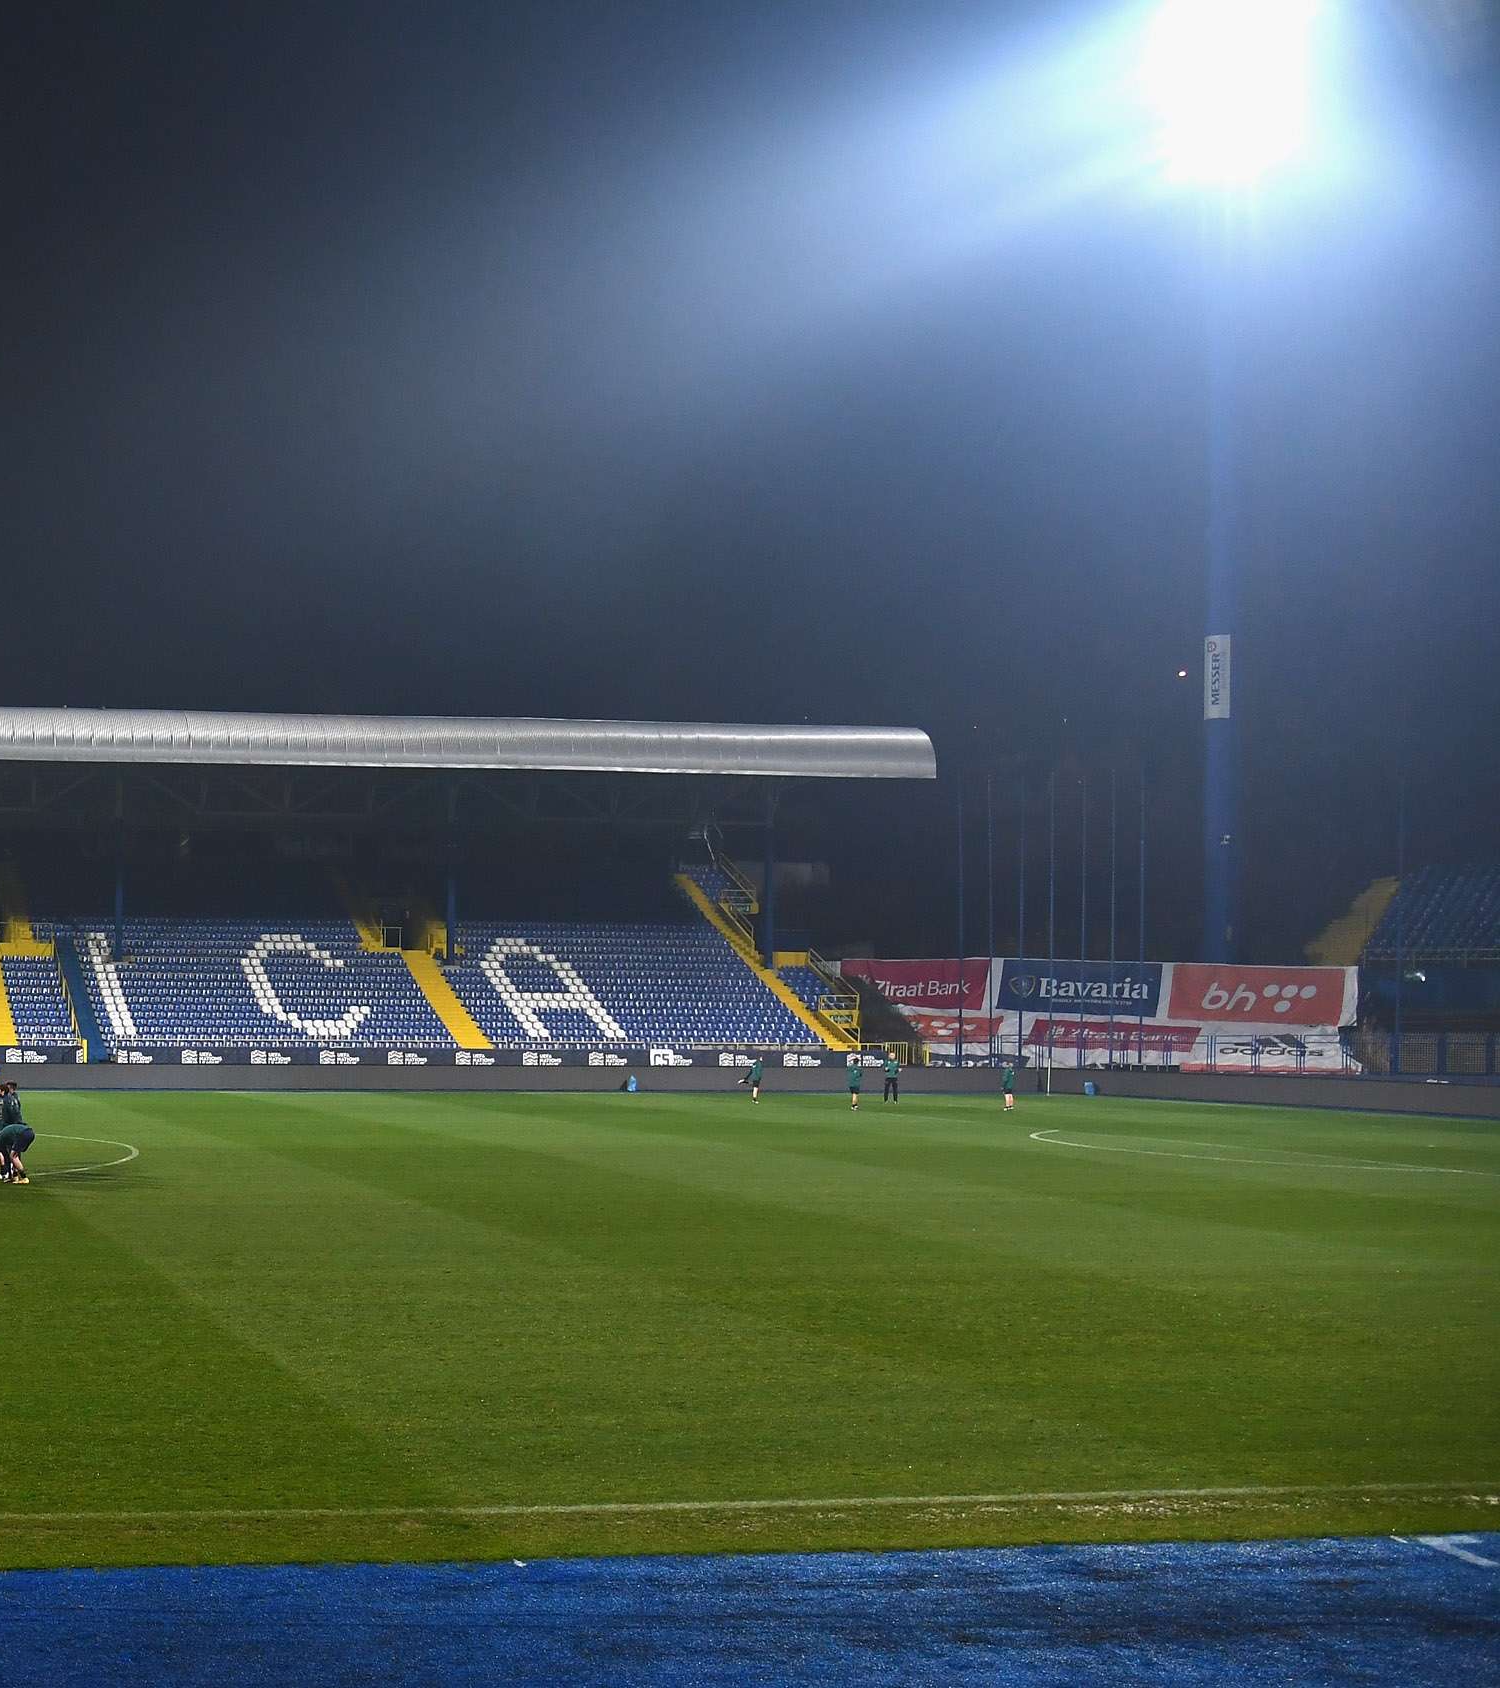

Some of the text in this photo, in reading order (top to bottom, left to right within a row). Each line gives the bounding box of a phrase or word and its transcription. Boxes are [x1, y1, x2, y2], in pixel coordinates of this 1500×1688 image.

[1212, 653, 1220, 706] MESSER
[874, 979, 970, 996] Ziraat Bank
[1039, 977, 1148, 1000] Bavaria
[1200, 982, 1256, 1011] bh
[1220, 1045, 1324, 1056] adidas
